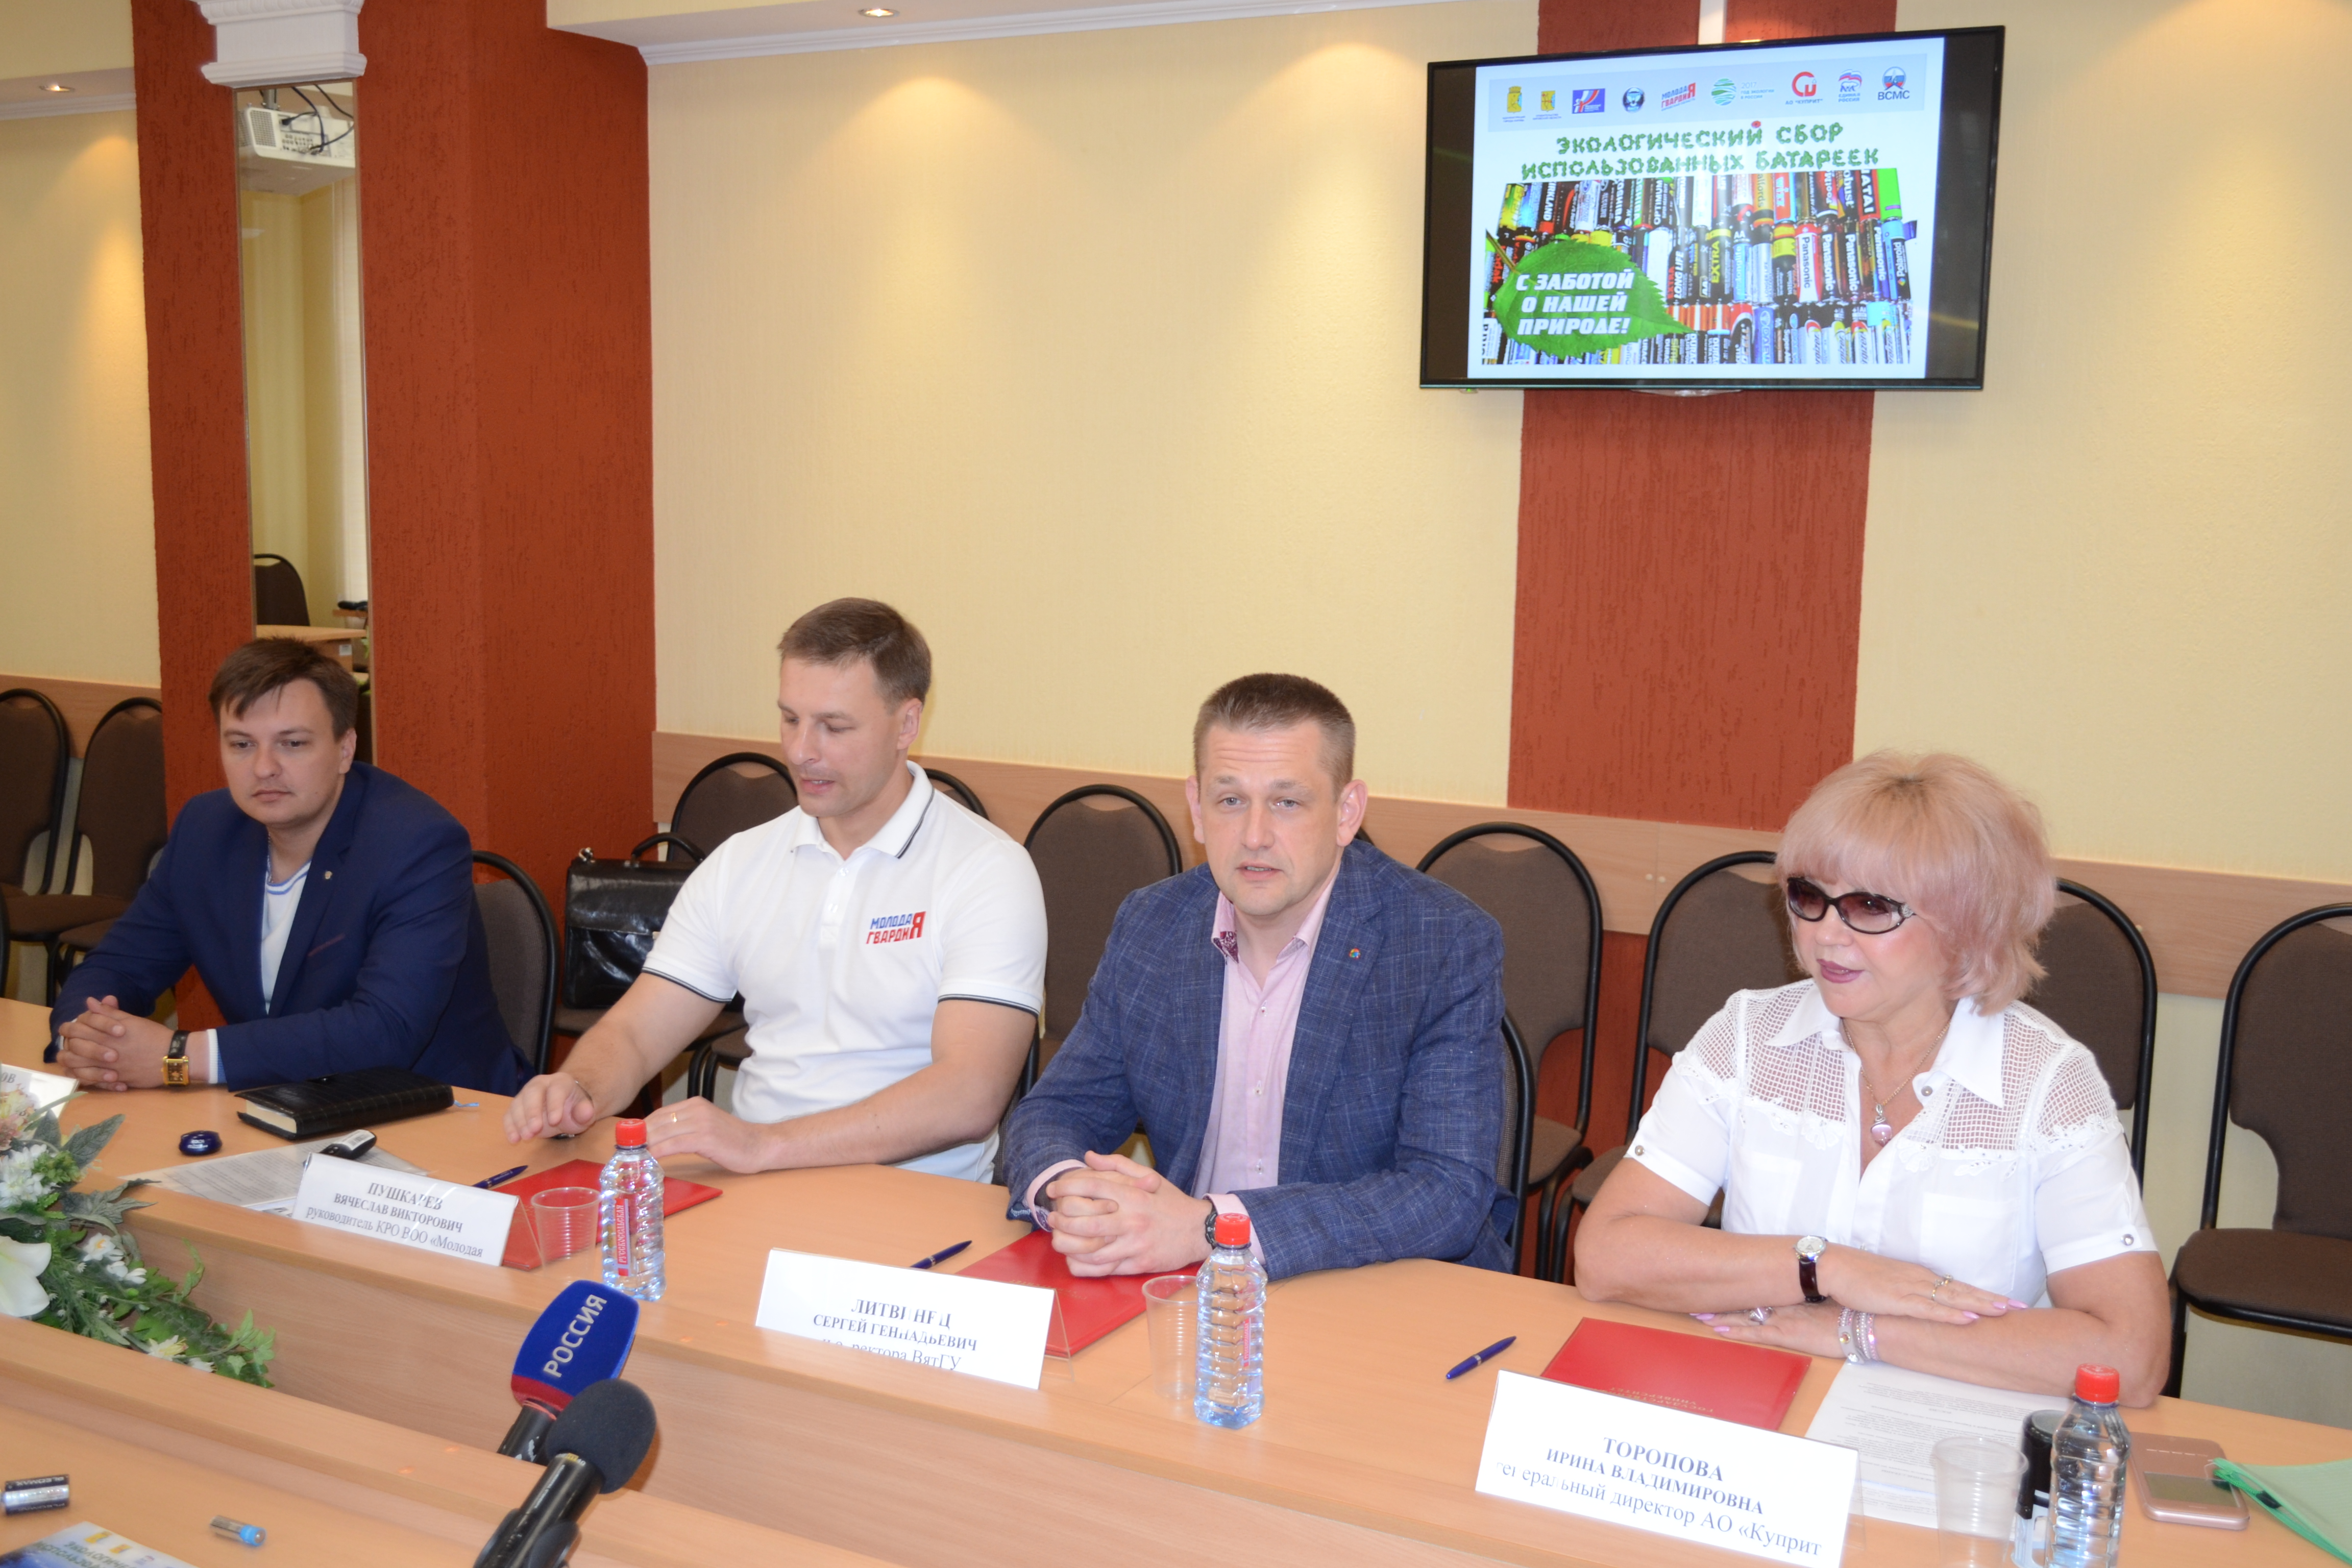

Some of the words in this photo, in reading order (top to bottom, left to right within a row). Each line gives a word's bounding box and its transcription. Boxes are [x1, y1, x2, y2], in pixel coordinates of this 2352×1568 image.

[1878, 90, 1909, 100] ВСМС
[1556, 124, 1762, 154] ЭКОЛОГИЧЕСКИЙ
[1775, 122, 1844, 145] СБОР
[1522, 154, 1745, 180] ИСПОЛЬЗОВАННЫХ
[1756, 148, 1879, 171] БАТАРЕЕК
[1654, 180, 1662, 225] OPTIMUM
[1675, 251, 1684, 271] LIFE
[1711, 241, 1721, 283] EXTRA
[1803, 236, 1811, 288] Panasonic
[1823, 234, 1833, 291] Panasonic
[1846, 234, 1857, 291] Panasonic
[1874, 227, 1886, 281] Panasonic
[1893, 241, 1906, 278] Polaroid
[1515, 273, 1530, 291] С
[1534, 268, 1634, 290] ЗАБОТОЙ
[1674, 272, 1683, 299] LONG
[1521, 296, 1537, 313] О
[1542, 291, 1628, 312] НАШЕЙ
[1516, 317, 1631, 335] ПРИРОДЕ!
[333, 1192, 389, 1215] ВЯЧЕСЛАВ
[389, 1206, 463, 1233] ВИКТОРОВИЧ
[367, 1182, 444, 1210] ПУШКАРЕВ
[305, 1206, 374, 1231] руководитель
[376, 1221, 400, 1237] КРО
[401, 1227, 428, 1244] ВОО
[430, 1234, 483, 1258] «Молодая
[543, 1294, 607, 1378] РОССИЯ
[813, 1313, 867, 1334] СЕРГЕЙ
[870, 1323, 977, 1352] ГЕННАДЬЕВИЧ
[912, 1349, 962, 1371] ВятГУ
[1609, 1387, 1697, 1406] УНИВЕРСИТЕТ
[1602, 1436, 1724, 1482] ТОРОПОВА
[1546, 1448, 1606, 1475] ИРИНА
[1610, 1464, 1764, 1515] ВЛАДИМИРОВНА
[1609, 1490, 1696, 1526] директор
[1700, 1510, 1734, 1533] АО
[1738, 1522, 1822, 1556] «Куприт
